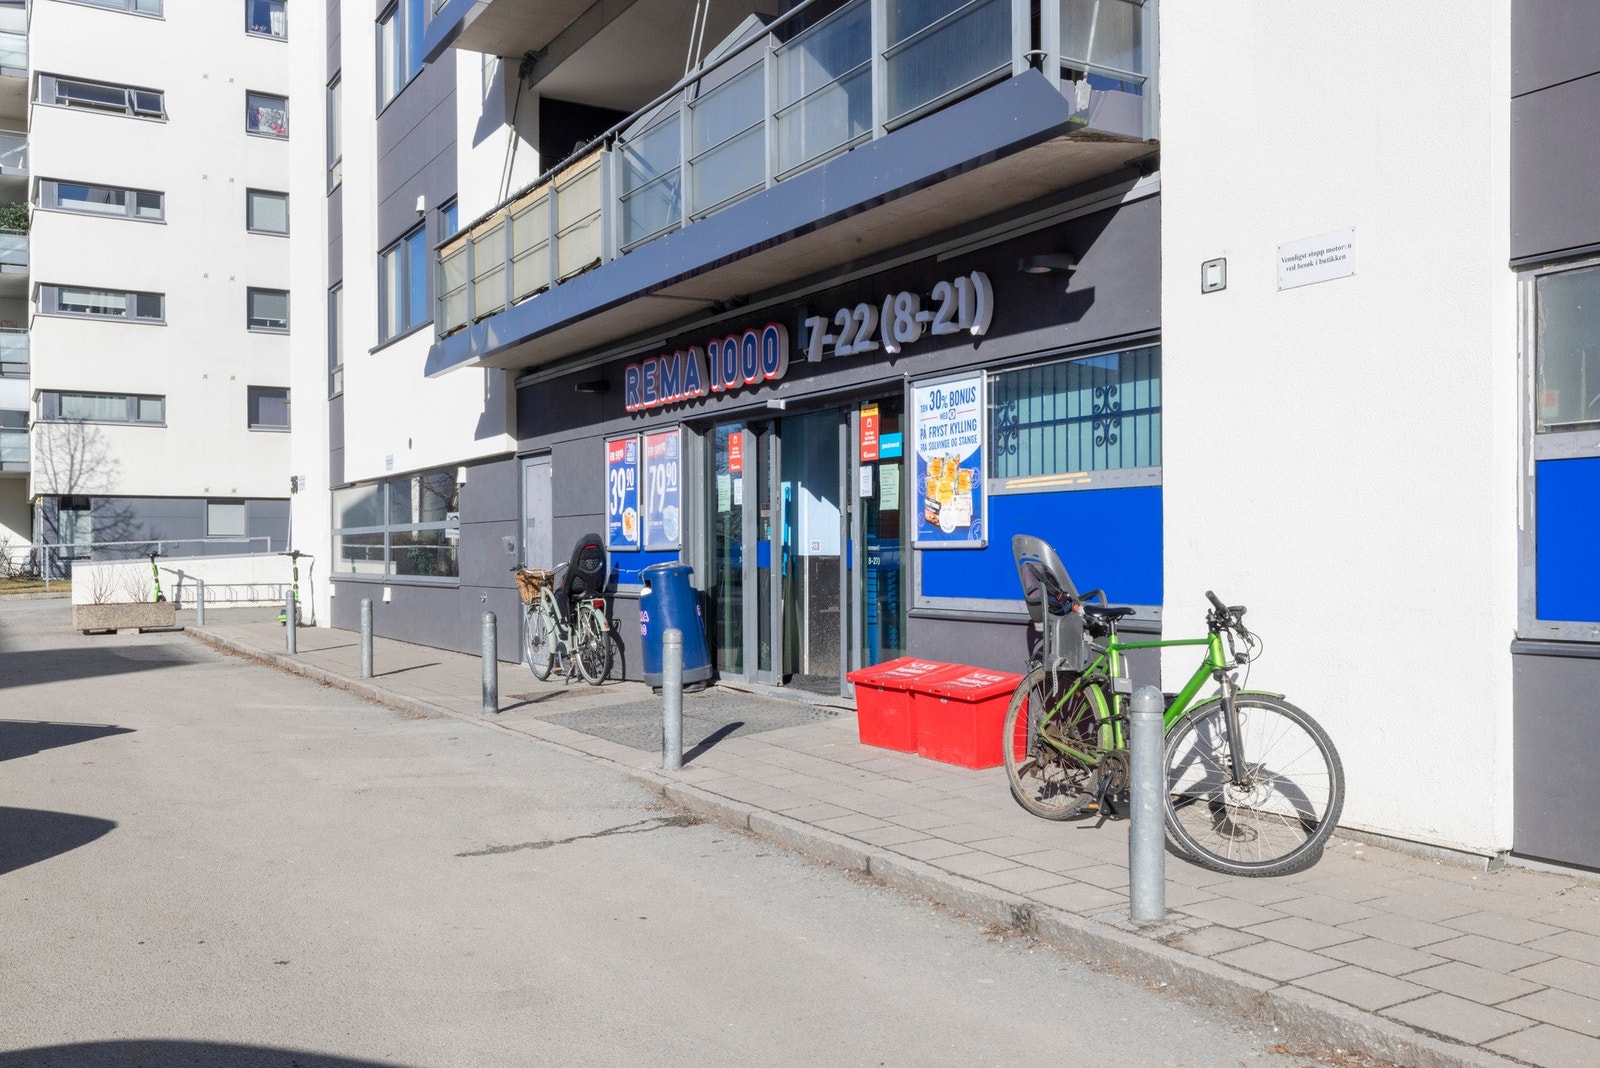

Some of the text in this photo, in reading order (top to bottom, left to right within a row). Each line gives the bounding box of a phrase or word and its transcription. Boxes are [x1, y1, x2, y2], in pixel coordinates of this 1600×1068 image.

[1281, 243, 1352, 263] Vennligst stopp motorn
[1318, 254, 1346, 265] butikken
[625, 321, 789, 413] REMA 1000
[929, 389, 948, 411] 30%
[949, 386, 976, 408] BONUS
[920, 418, 977, 440] PÅ FRYST KYLLING
[950, 437, 957, 447] OG
[958, 434, 978, 446] STANGE
[610, 467, 626, 516] 39
[626, 468, 634, 487] 90
[649, 463, 666, 513] 79
[666, 461, 677, 486] 90
[973, 673, 1003, 681] VG
